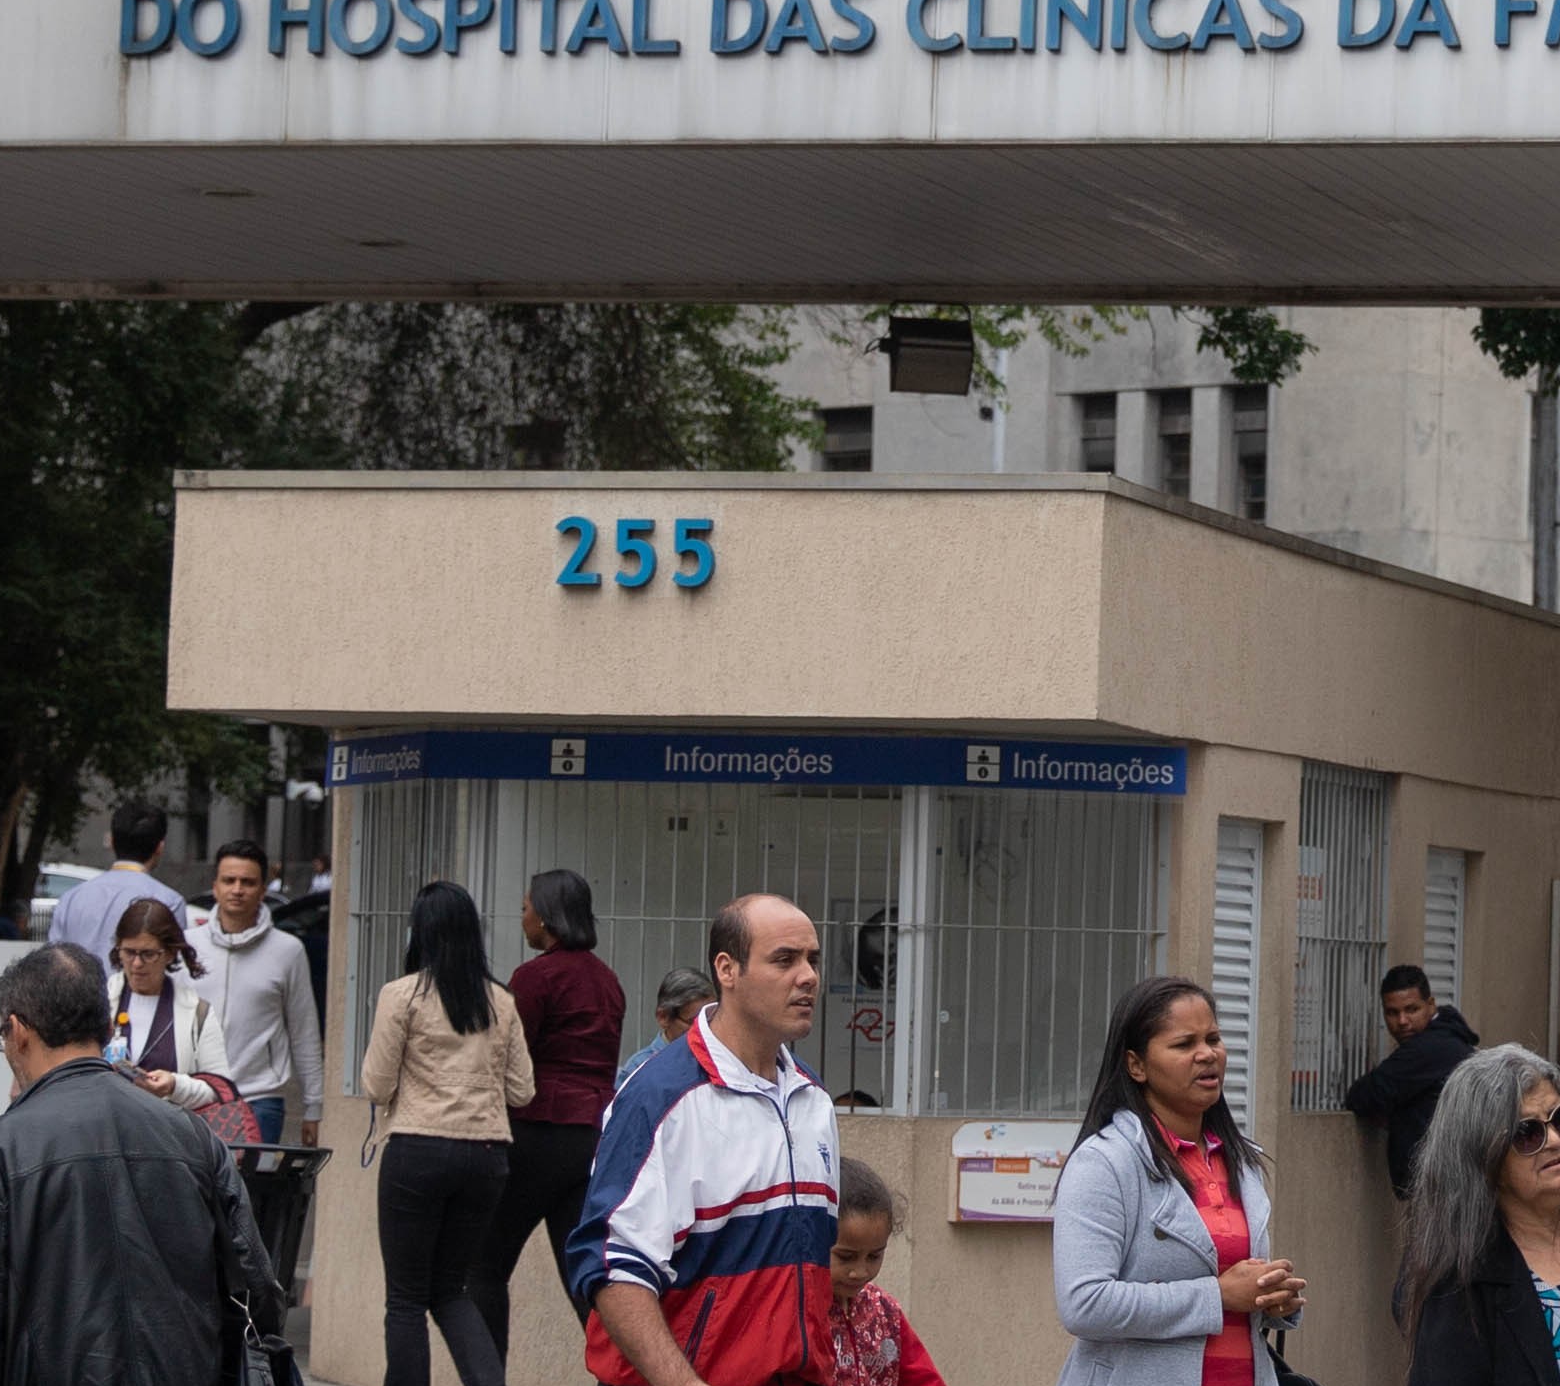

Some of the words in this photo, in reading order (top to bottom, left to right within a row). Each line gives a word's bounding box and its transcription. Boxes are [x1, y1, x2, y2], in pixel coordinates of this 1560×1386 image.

[555, 516, 717, 590] 255
[351, 745, 422, 778] Informações
[665, 746, 833, 781] Informações
[1013, 752, 1175, 792] Informações
